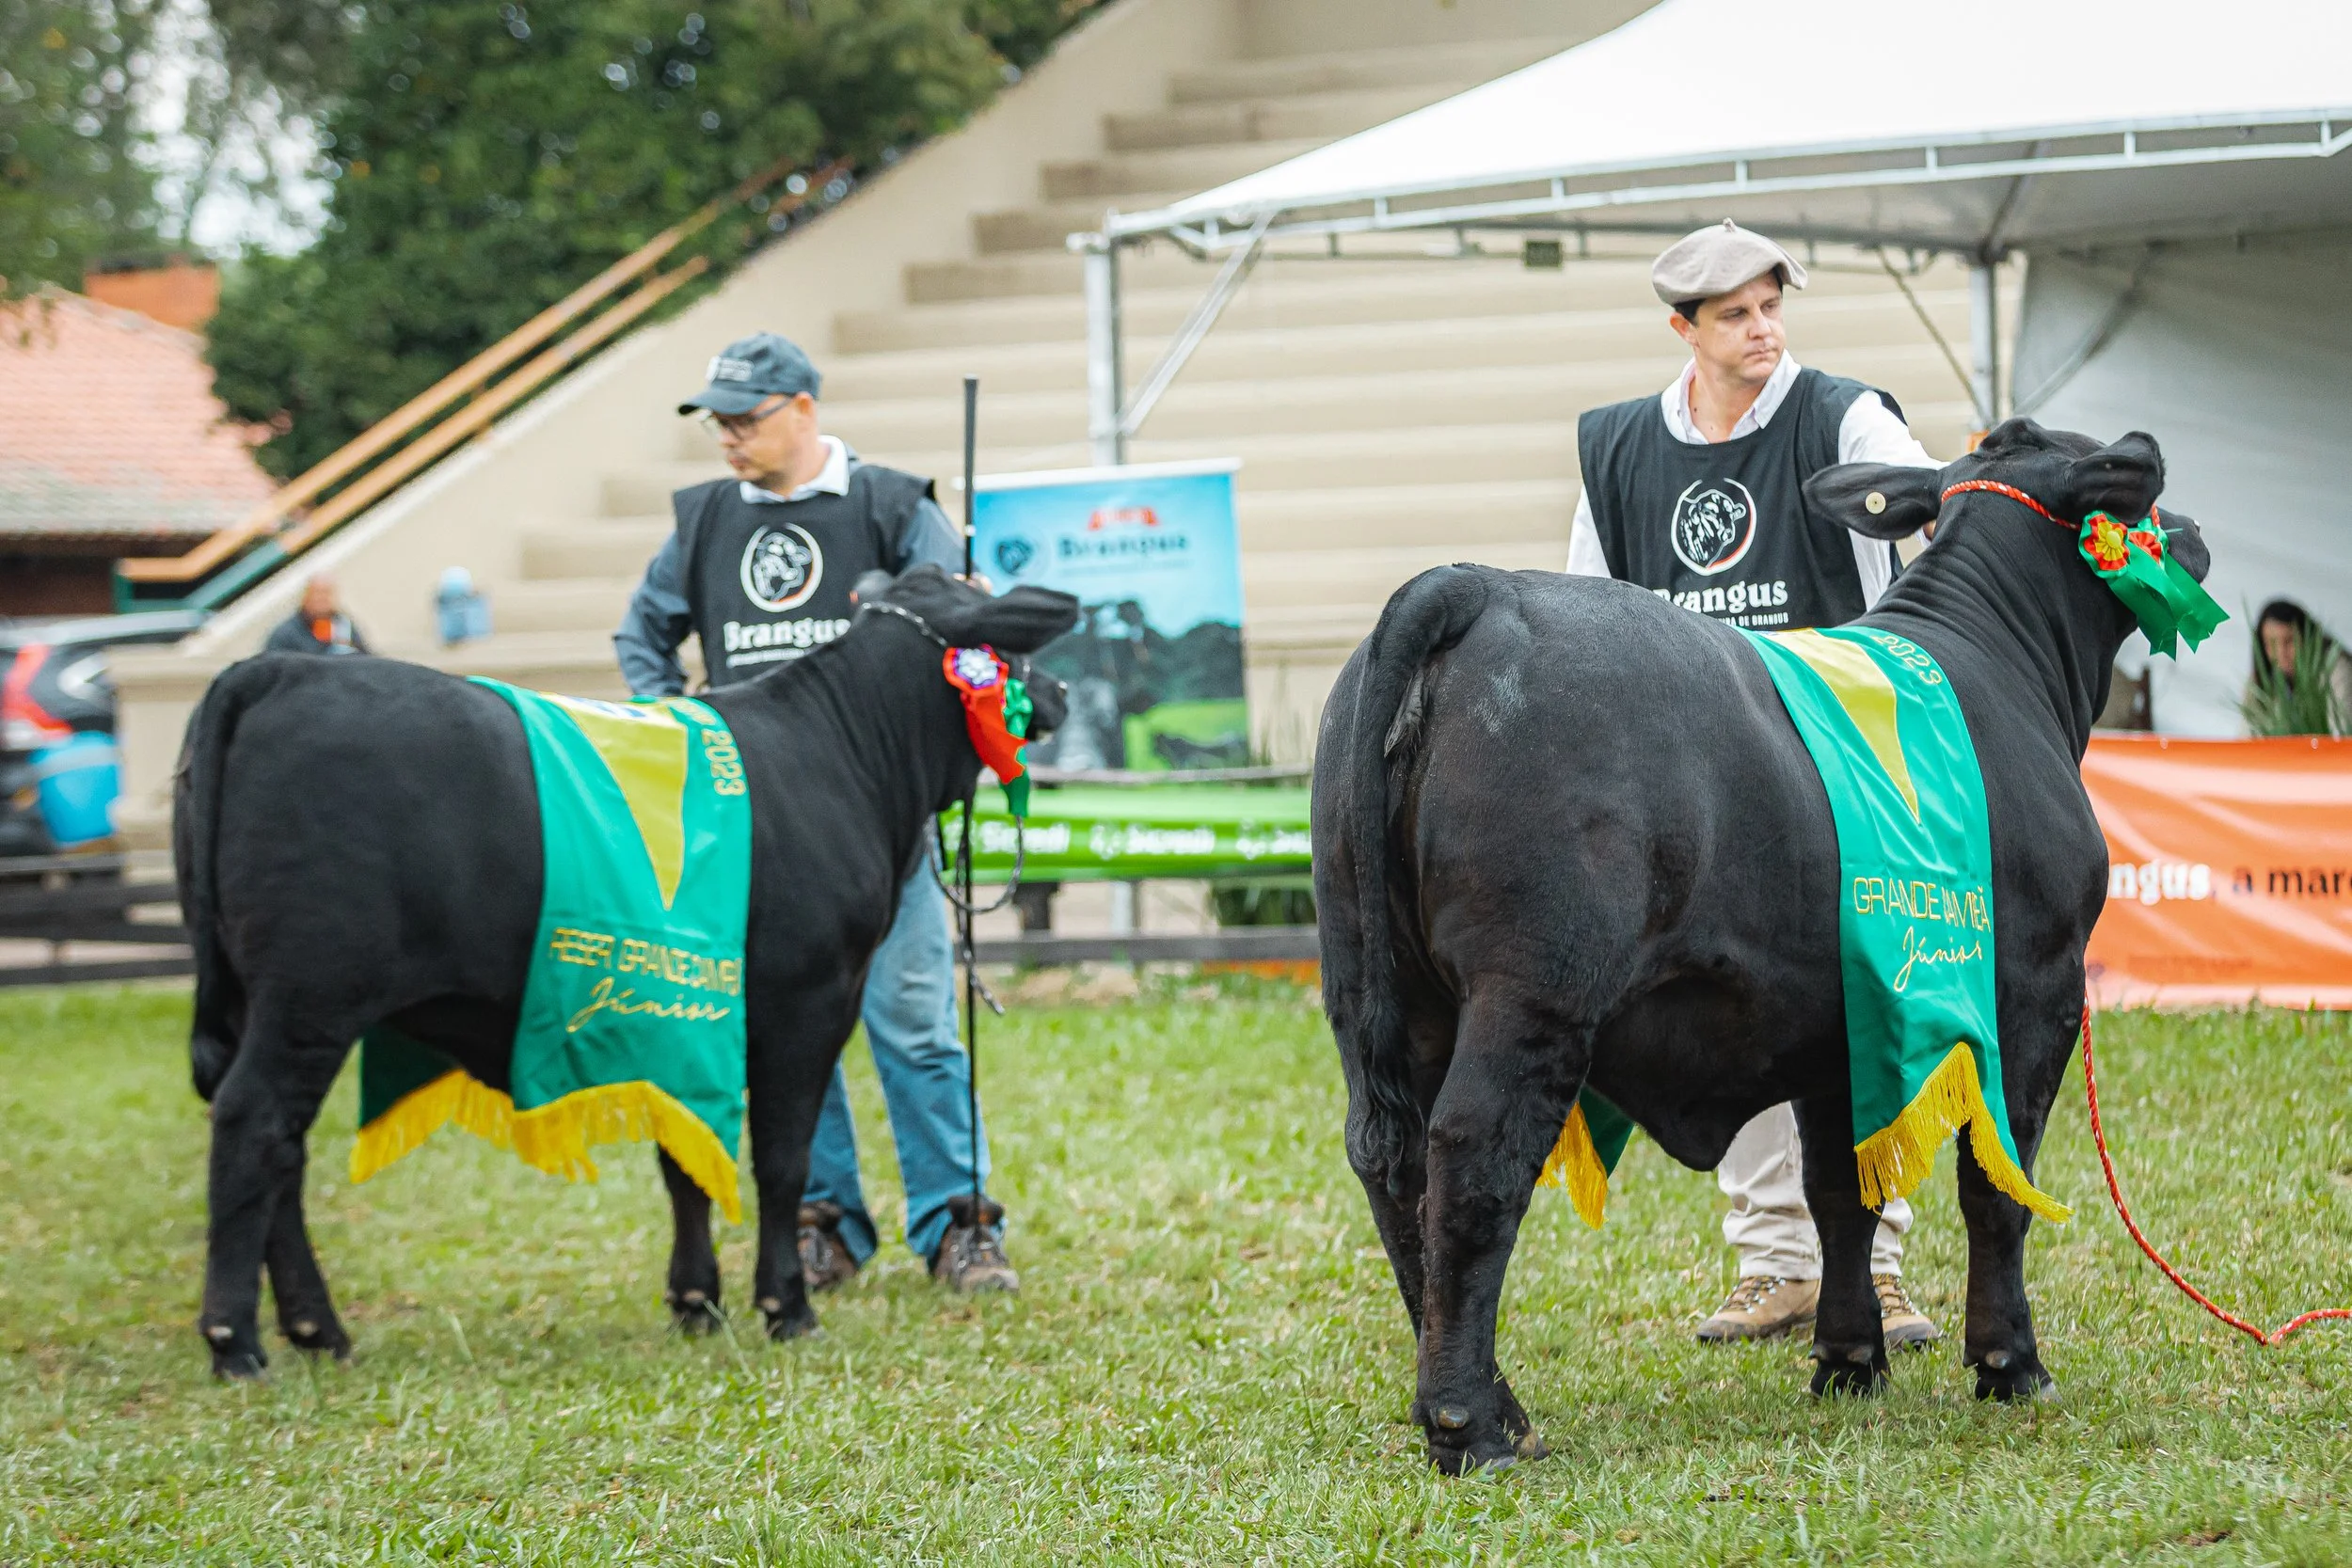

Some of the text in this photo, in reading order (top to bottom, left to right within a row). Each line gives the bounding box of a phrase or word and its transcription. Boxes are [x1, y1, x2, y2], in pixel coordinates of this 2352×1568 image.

[701, 728, 748, 797] 2023
[1853, 877, 1942, 920] GRANDE
[2233, 867, 2254, 895] a
